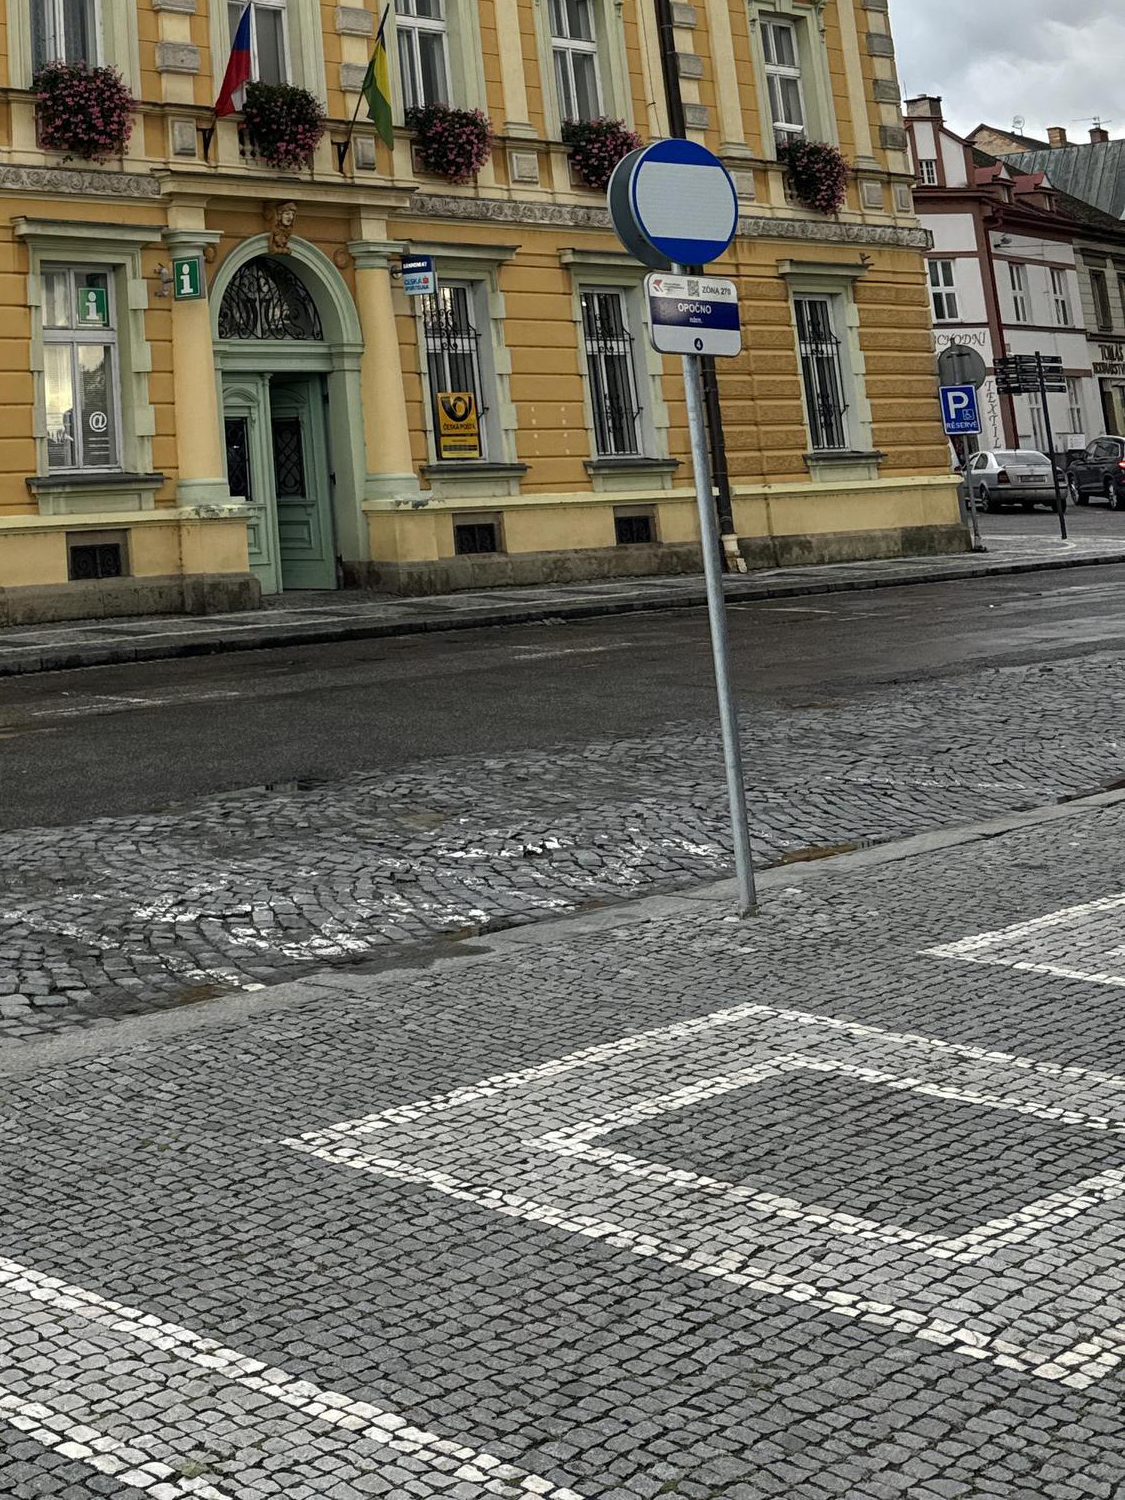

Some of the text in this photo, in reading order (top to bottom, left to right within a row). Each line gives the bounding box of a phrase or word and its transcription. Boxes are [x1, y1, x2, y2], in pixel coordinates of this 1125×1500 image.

[702, 285, 720, 295] ZÓNA
[677, 302, 712, 315] OPOČNO
[946, 391, 969, 419] P
[984, 380, 1002, 449] TEXTIL
